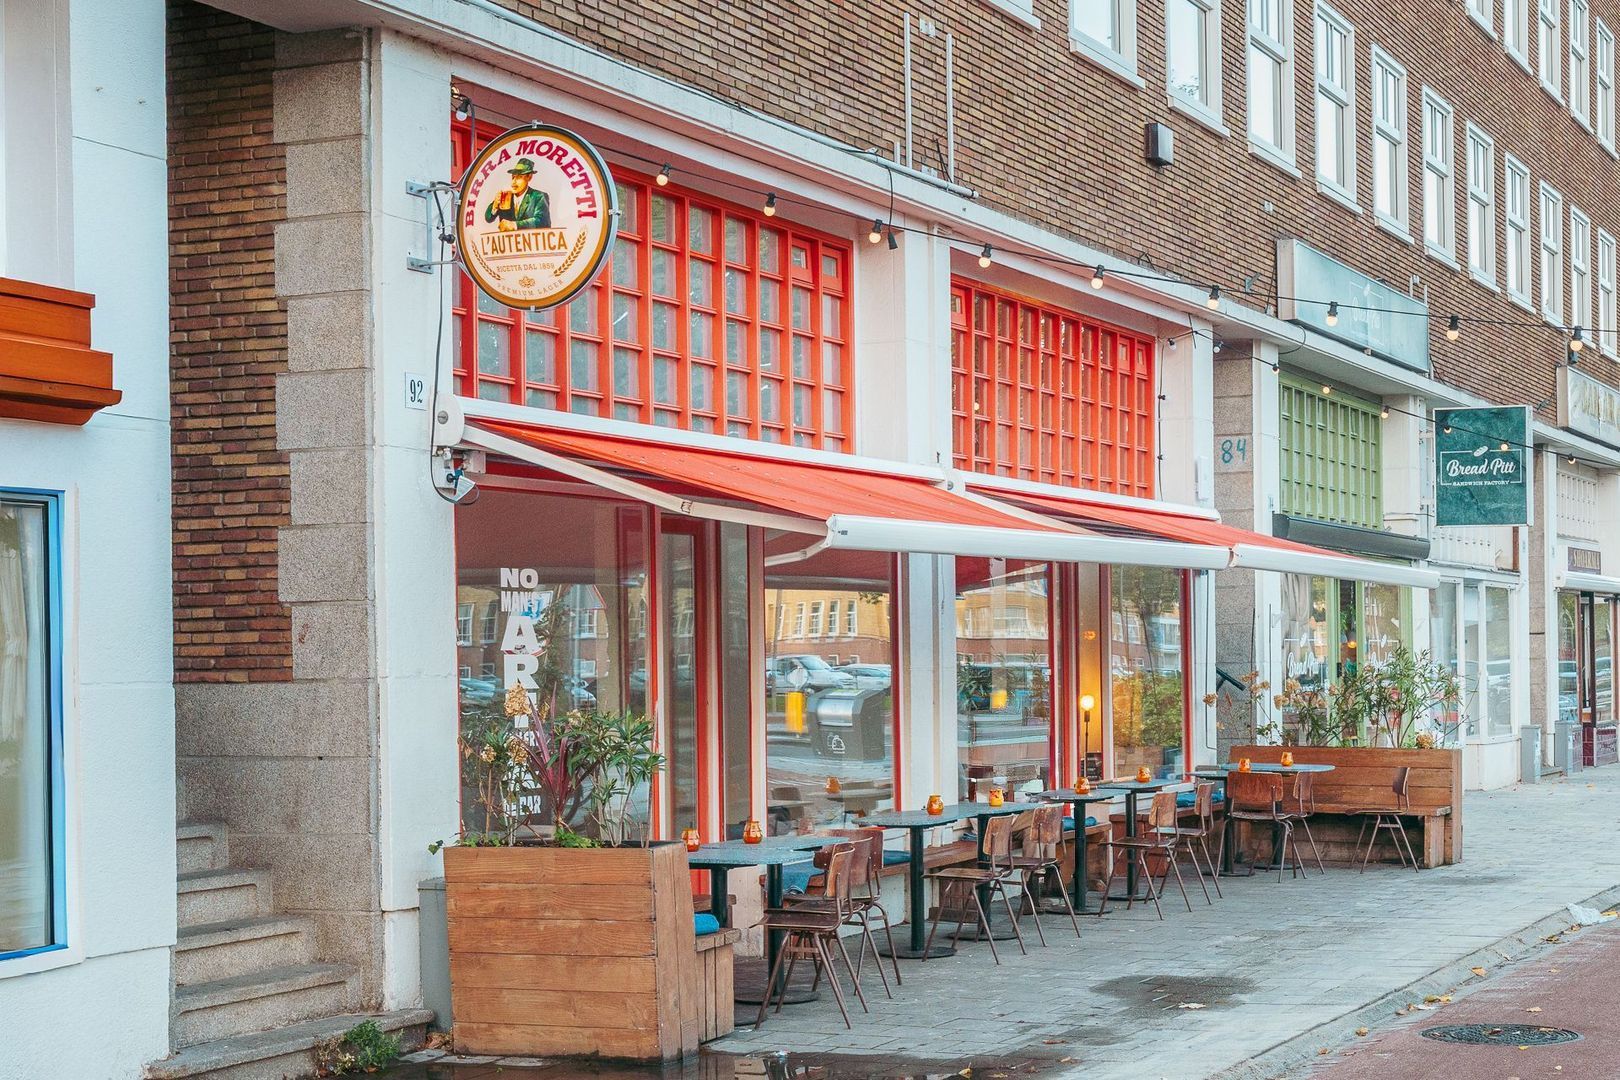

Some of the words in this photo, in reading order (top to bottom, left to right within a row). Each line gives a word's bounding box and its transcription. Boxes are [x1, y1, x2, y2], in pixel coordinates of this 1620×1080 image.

[466, 148, 511, 227] BIRRA
[515, 140, 598, 219] MORETTI
[481, 231, 568, 256] L'AUTENTICA
[523, 263, 538, 271] DAL
[410, 379, 423, 403] 92
[1221, 438, 1246, 463] 84
[1446, 458, 1490, 477] Bread
[1490, 458, 1516, 476] Pitt
[500, 567, 539, 589] NO
